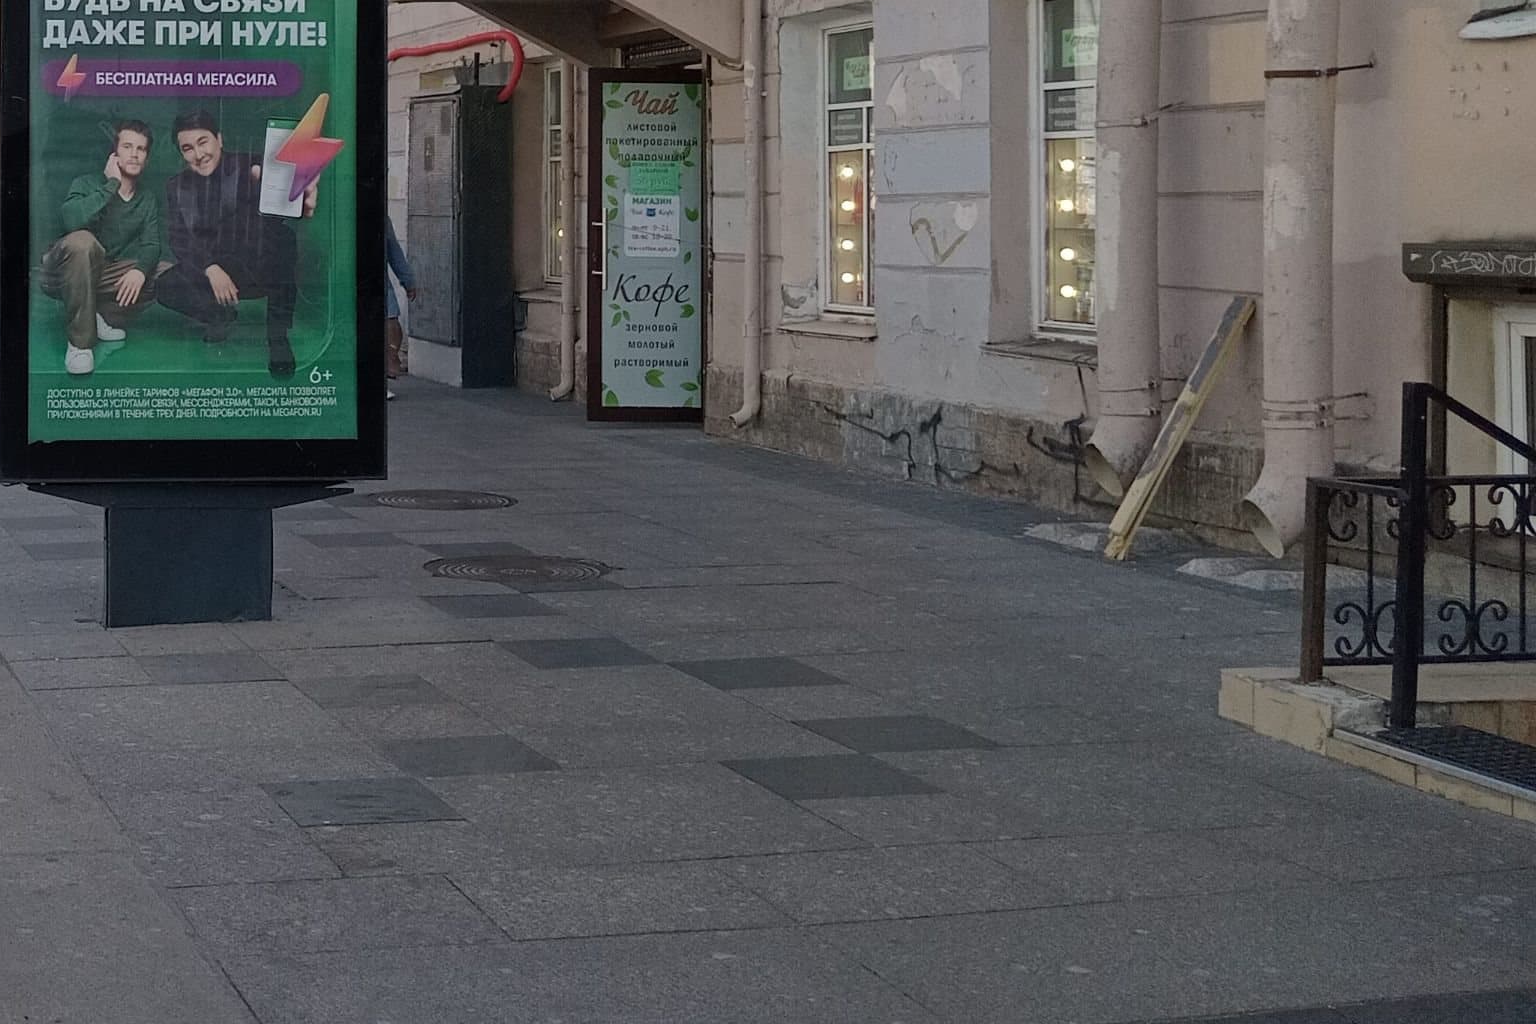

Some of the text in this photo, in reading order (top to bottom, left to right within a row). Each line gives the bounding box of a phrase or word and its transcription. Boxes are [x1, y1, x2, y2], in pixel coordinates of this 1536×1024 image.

[42, 20, 327, 48] ДАЖЕ ПРИ НУЛЕ!
[95, 72, 277, 87] БЕСПЛАТНАЯ МЕГАСИЛА
[624, 89, 680, 115] Чай
[626, 122, 677, 132] листовой
[605, 137, 698, 147] пакетированный
[632, 197, 672, 205] МАГАЗИН
[613, 272, 690, 317] Кофе
[625, 323, 678, 333] зерновой
[628, 339, 675, 349] молотый
[614, 358, 689, 368] растворимый
[309, 366, 333, 384] 6+
[47, 388, 94, 398] ДОСТУПНО
[103, 387, 140, 397] ЛИНЕЙКЕ
[142, 388, 179, 397] ТАРИФОВ
[246, 387, 287, 396] МЕГАСИЛА
[289, 386, 336, 396] ПОЗВОЛЯЕТ
[47, 398, 109, 408] ПОЛЬЗОВАТЬСЯ
[109, 398, 150, 408] УСЛУГАМИ
[280, 396, 337, 406] БАНКОВСКИМИ
[47, 409, 113, 419] ПРИЛОЖЕНИЯМИ
[122, 409, 154, 418] ТЕЧЕНИЕ
[200, 407, 259, 418] ПОДРОБНОСТИ
[260, 407, 271, 417] НА
[272, 407, 322, 417] MEGAFON.RU
